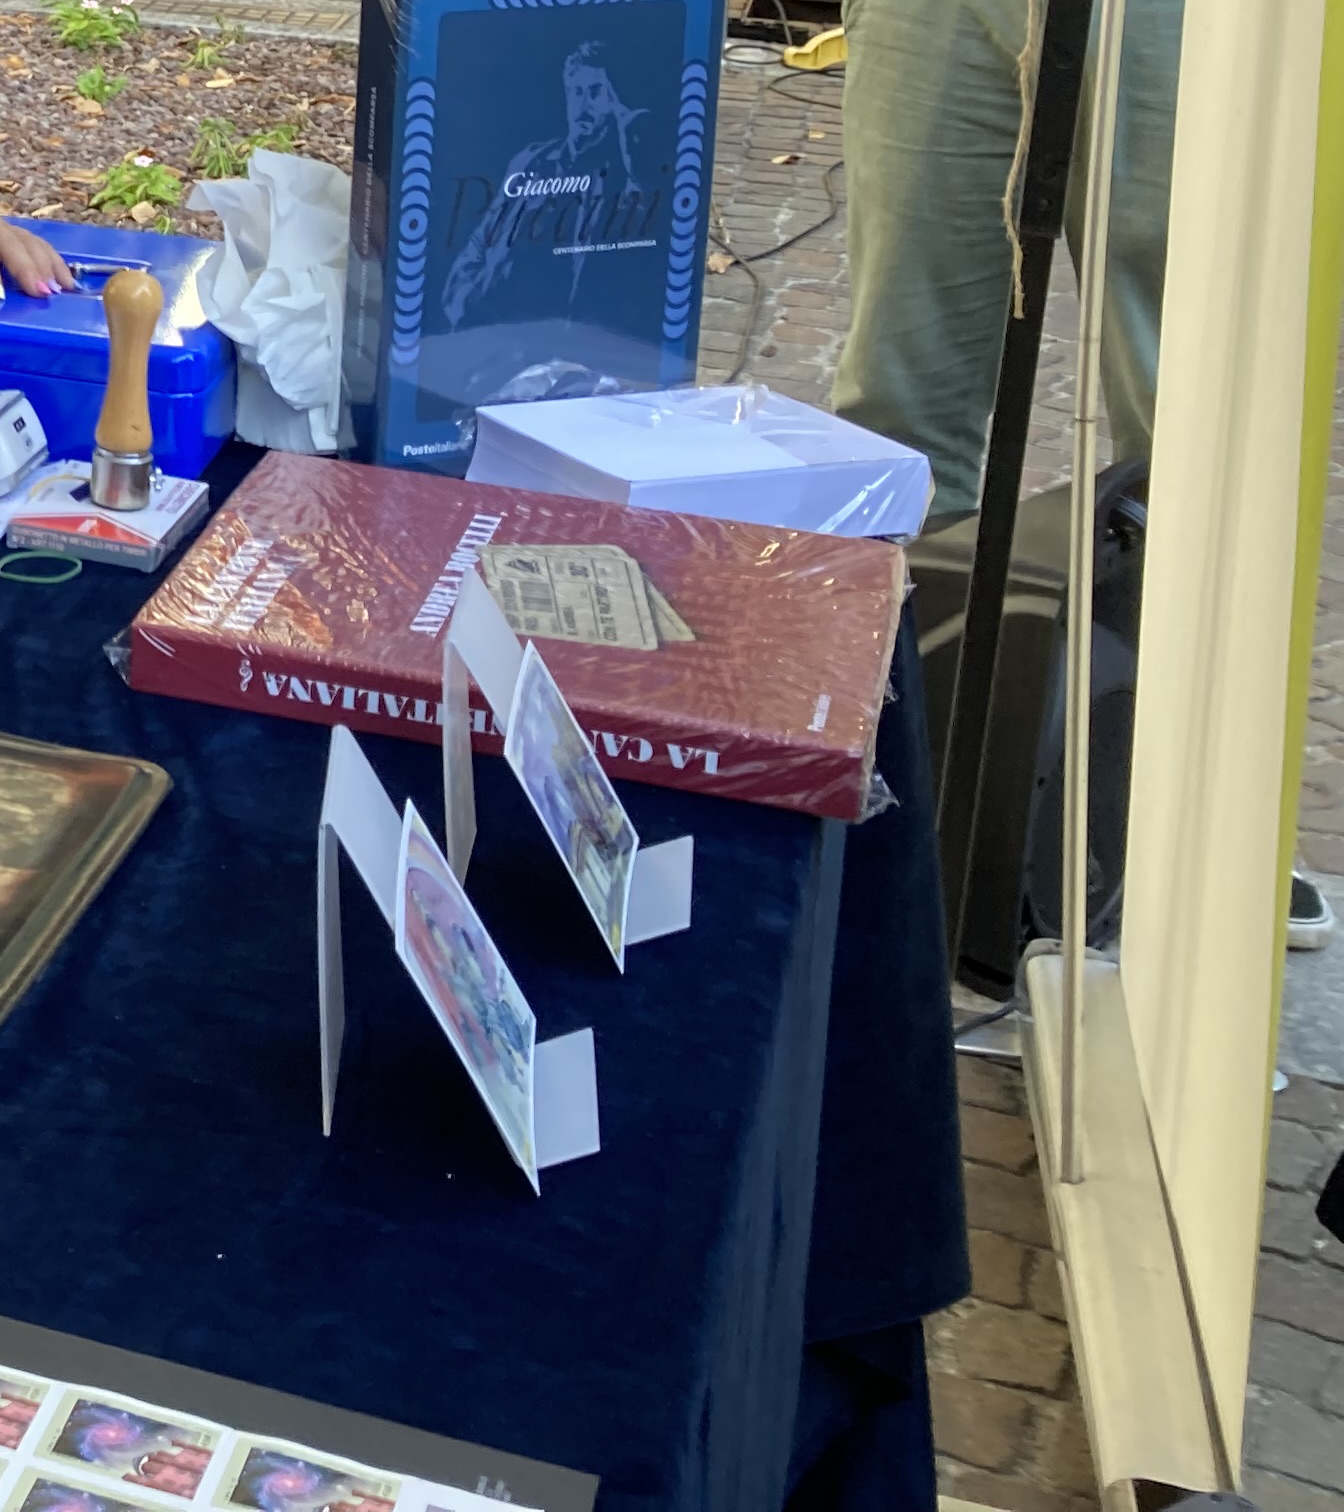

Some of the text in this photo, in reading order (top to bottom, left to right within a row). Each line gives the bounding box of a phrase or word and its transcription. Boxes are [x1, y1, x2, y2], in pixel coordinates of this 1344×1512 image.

[363, 188, 372, 255] CENTENARIO
[368, 87, 377, 151] SCOMPARSA
[504, 171, 591, 198] Giacomo
[444, 162, 666, 250] Puccini
[409, 574, 464, 638] ANDREA
[262, 670, 445, 727] ITALIANA
[666, 742, 720, 775] LA
